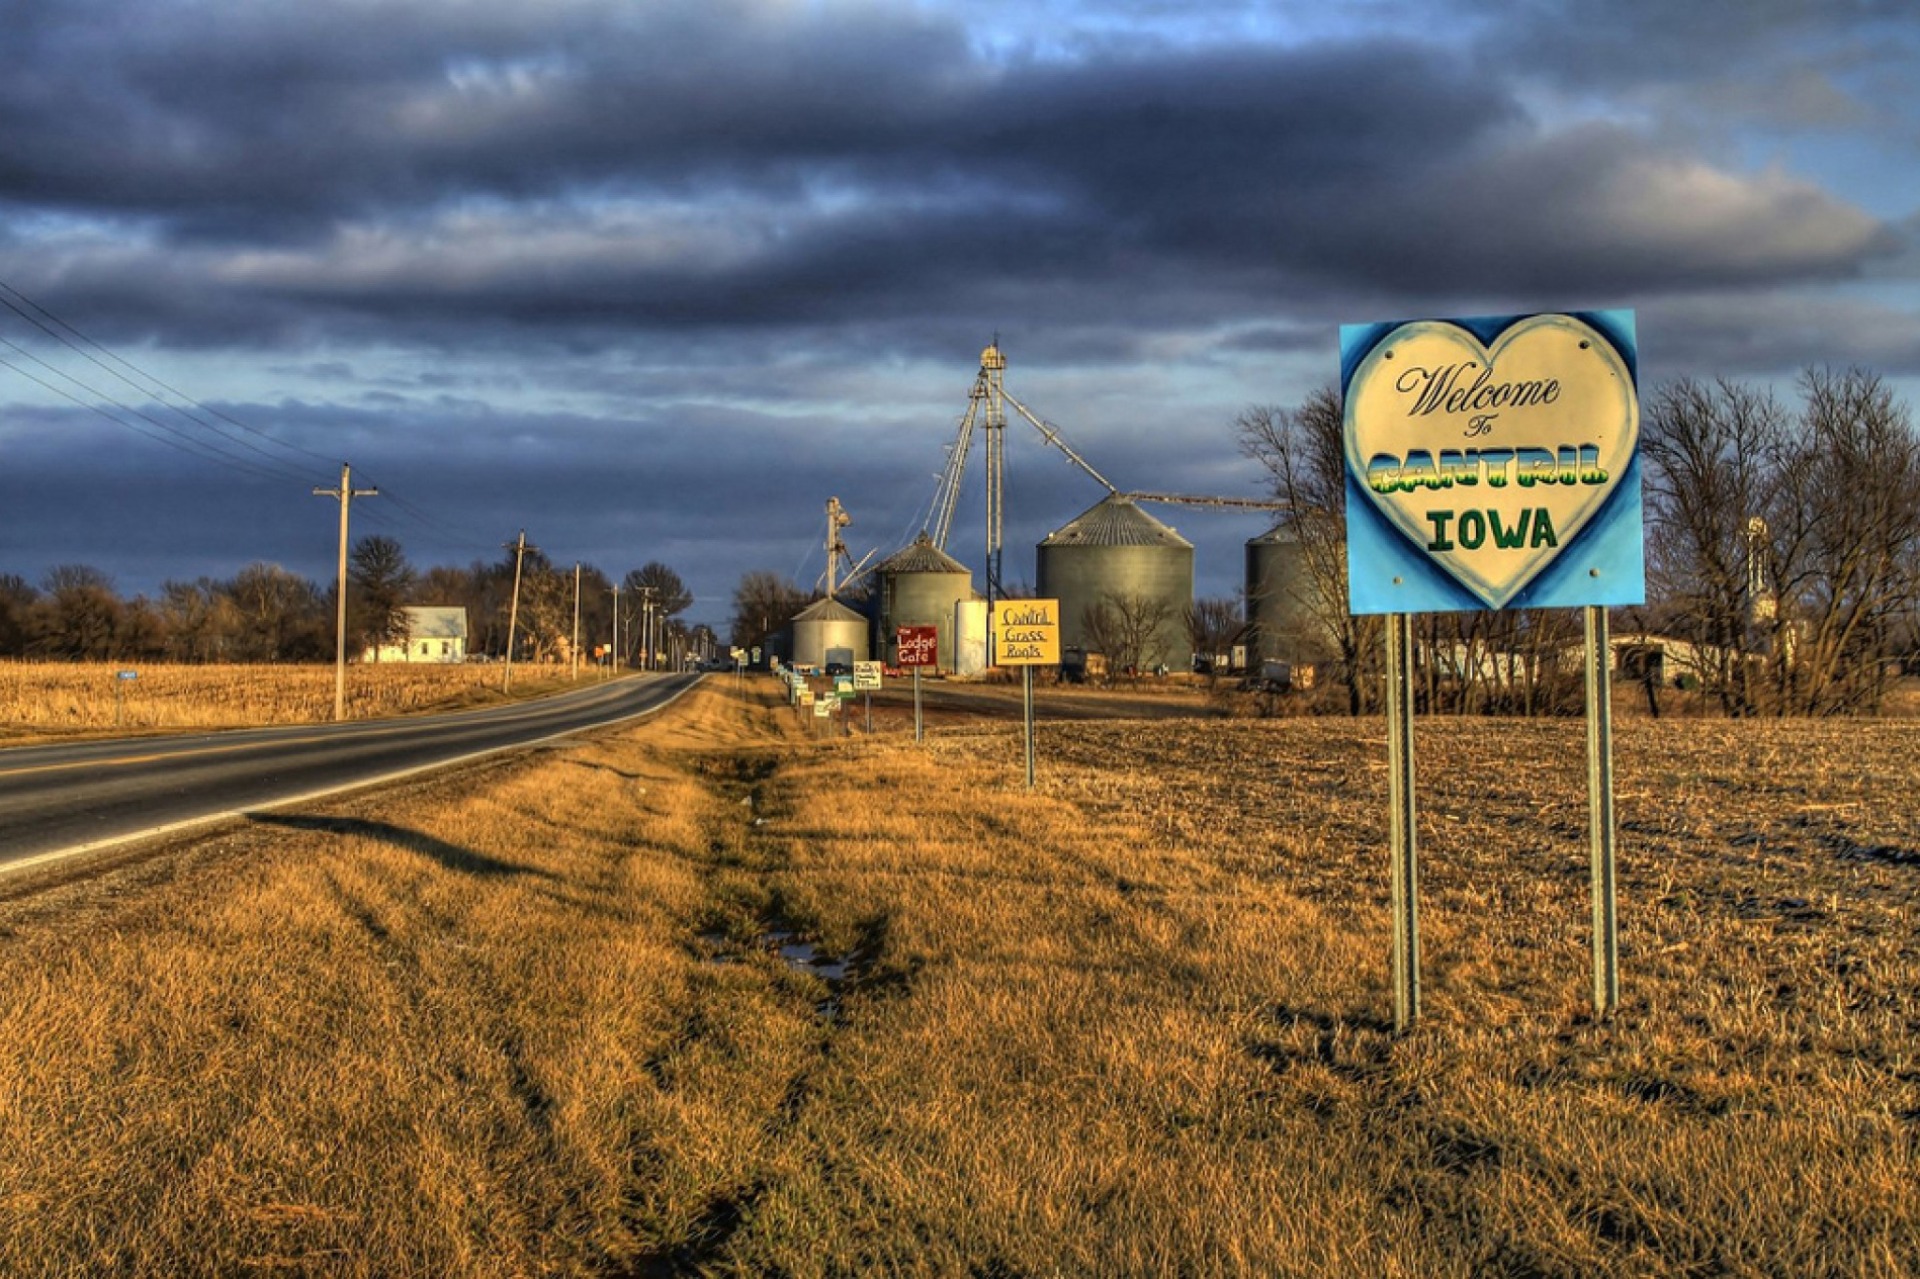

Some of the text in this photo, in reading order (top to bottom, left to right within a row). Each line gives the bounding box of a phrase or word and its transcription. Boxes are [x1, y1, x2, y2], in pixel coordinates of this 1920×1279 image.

[1396, 361, 1561, 417] Welcome
[1463, 414, 1498, 438] To
[1366, 443, 1609, 494] CANTRIL
[1426, 508, 1558, 552] IOWA
[897, 633, 936, 652] Lodge
[1005, 626, 1046, 642] Grass
